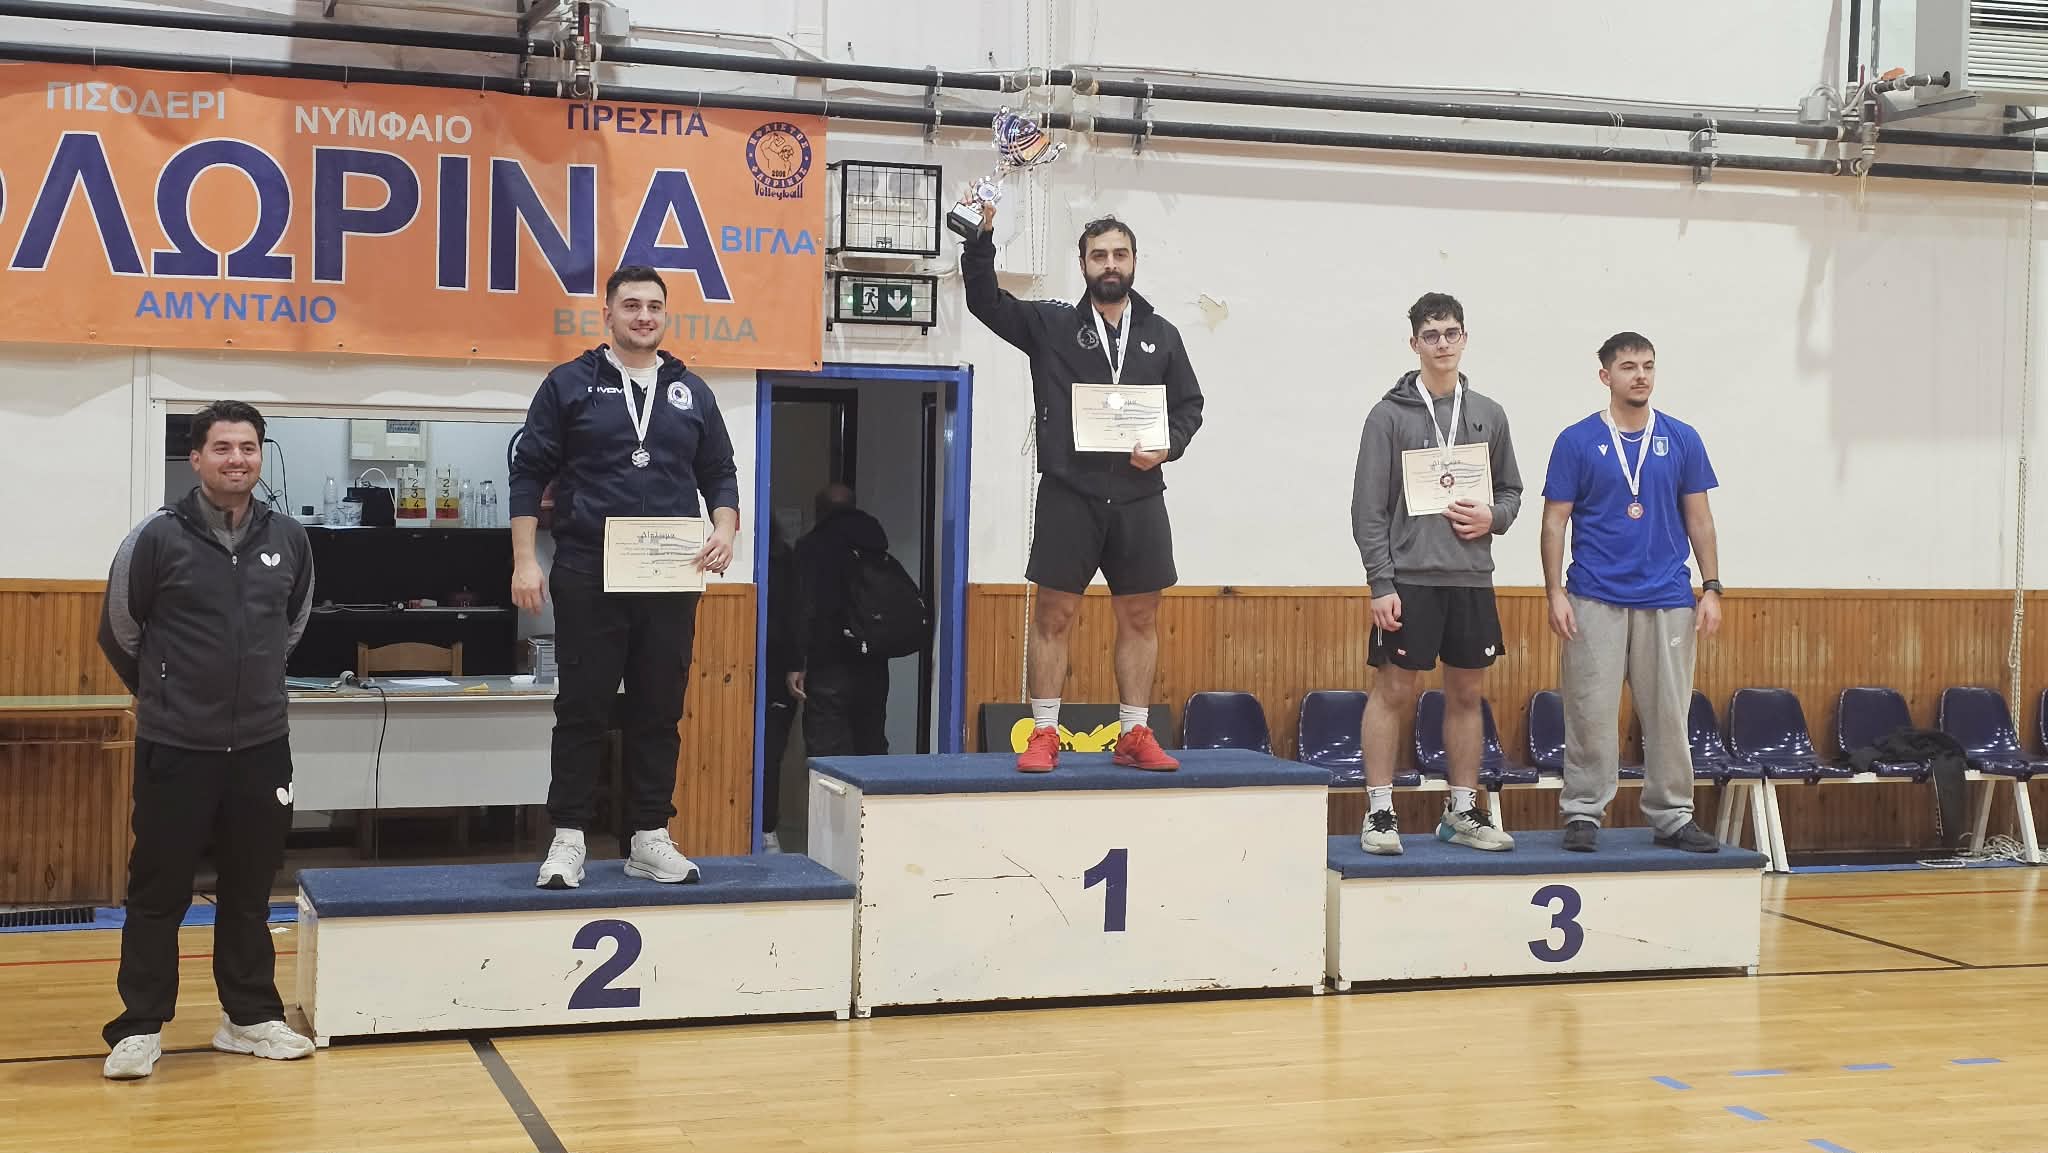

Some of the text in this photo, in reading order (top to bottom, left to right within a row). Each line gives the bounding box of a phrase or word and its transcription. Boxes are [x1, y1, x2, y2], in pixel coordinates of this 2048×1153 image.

[46, 81, 226, 120] ΠΙΣΟΔΕΡΙ
[294, 104, 473, 144] ΝΥΜΦΑΙΟ
[566, 103, 710, 137] ΠΡΕΣΠΑ
[754, 179, 803, 200] Volleyball
[0, 130, 735, 304] ΛΩΡΙΝΑ
[720, 225, 817, 256] ΒΙΓΛΑ
[135, 290, 337, 324] ΑΜΥΝΤΑΙΟ
[553, 308, 758, 343] ΒΕΙΤΙΔΑ
[443, 478, 450, 488] 2
[1083, 848, 1129, 933] 1
[1528, 884, 1584, 963] 3
[567, 919, 642, 1010] 2
